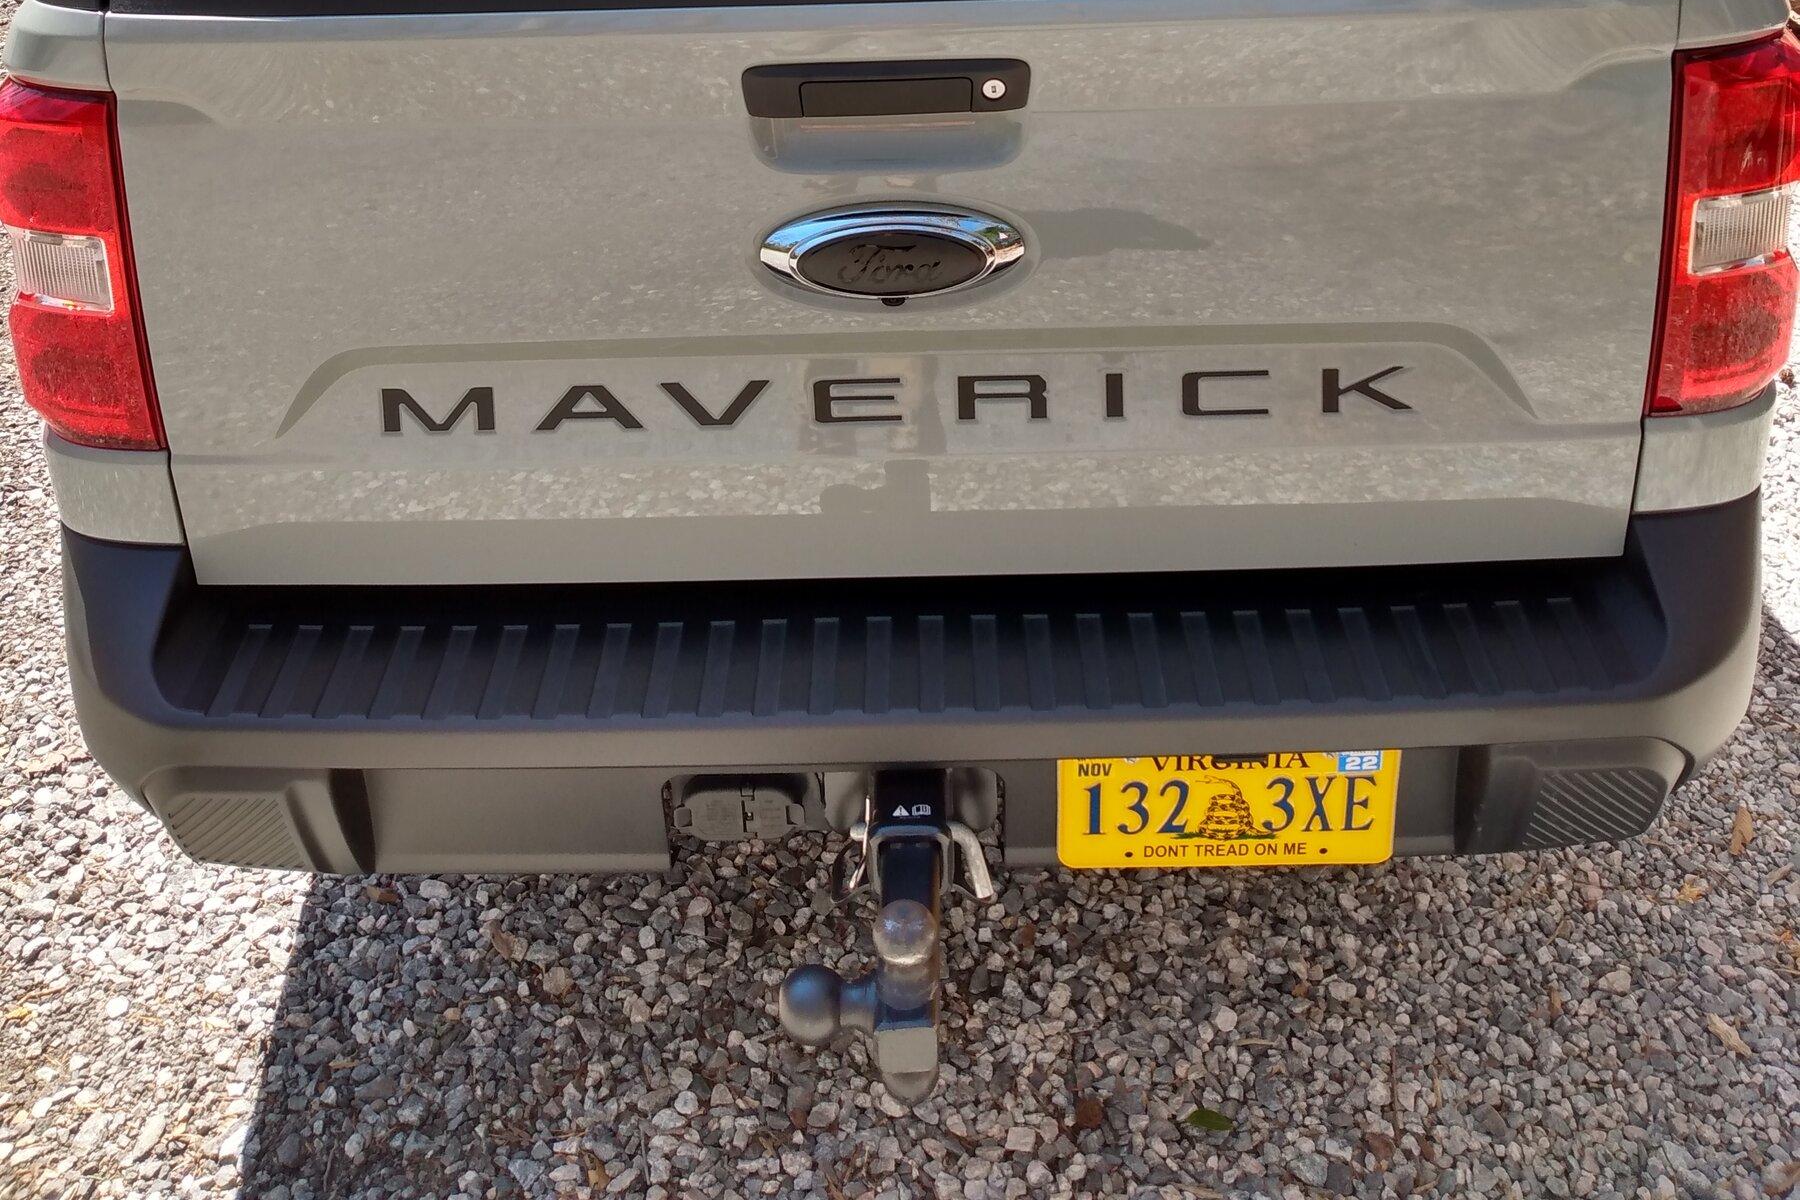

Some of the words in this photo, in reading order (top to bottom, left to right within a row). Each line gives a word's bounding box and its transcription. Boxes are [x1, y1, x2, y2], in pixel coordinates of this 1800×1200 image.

[382, 366, 1412, 431] MAVERICK
[1078, 763, 1112, 777] NOV
[1345, 756, 1378, 770] 22
[1082, 780, 1189, 835] 132
[1262, 775, 1377, 832] 3XE
[1144, 845, 1188, 858] DONT
[1195, 843, 1249, 856] TREAD
[1254, 842, 1278, 856] ON
[1283, 842, 1307, 855] ME
